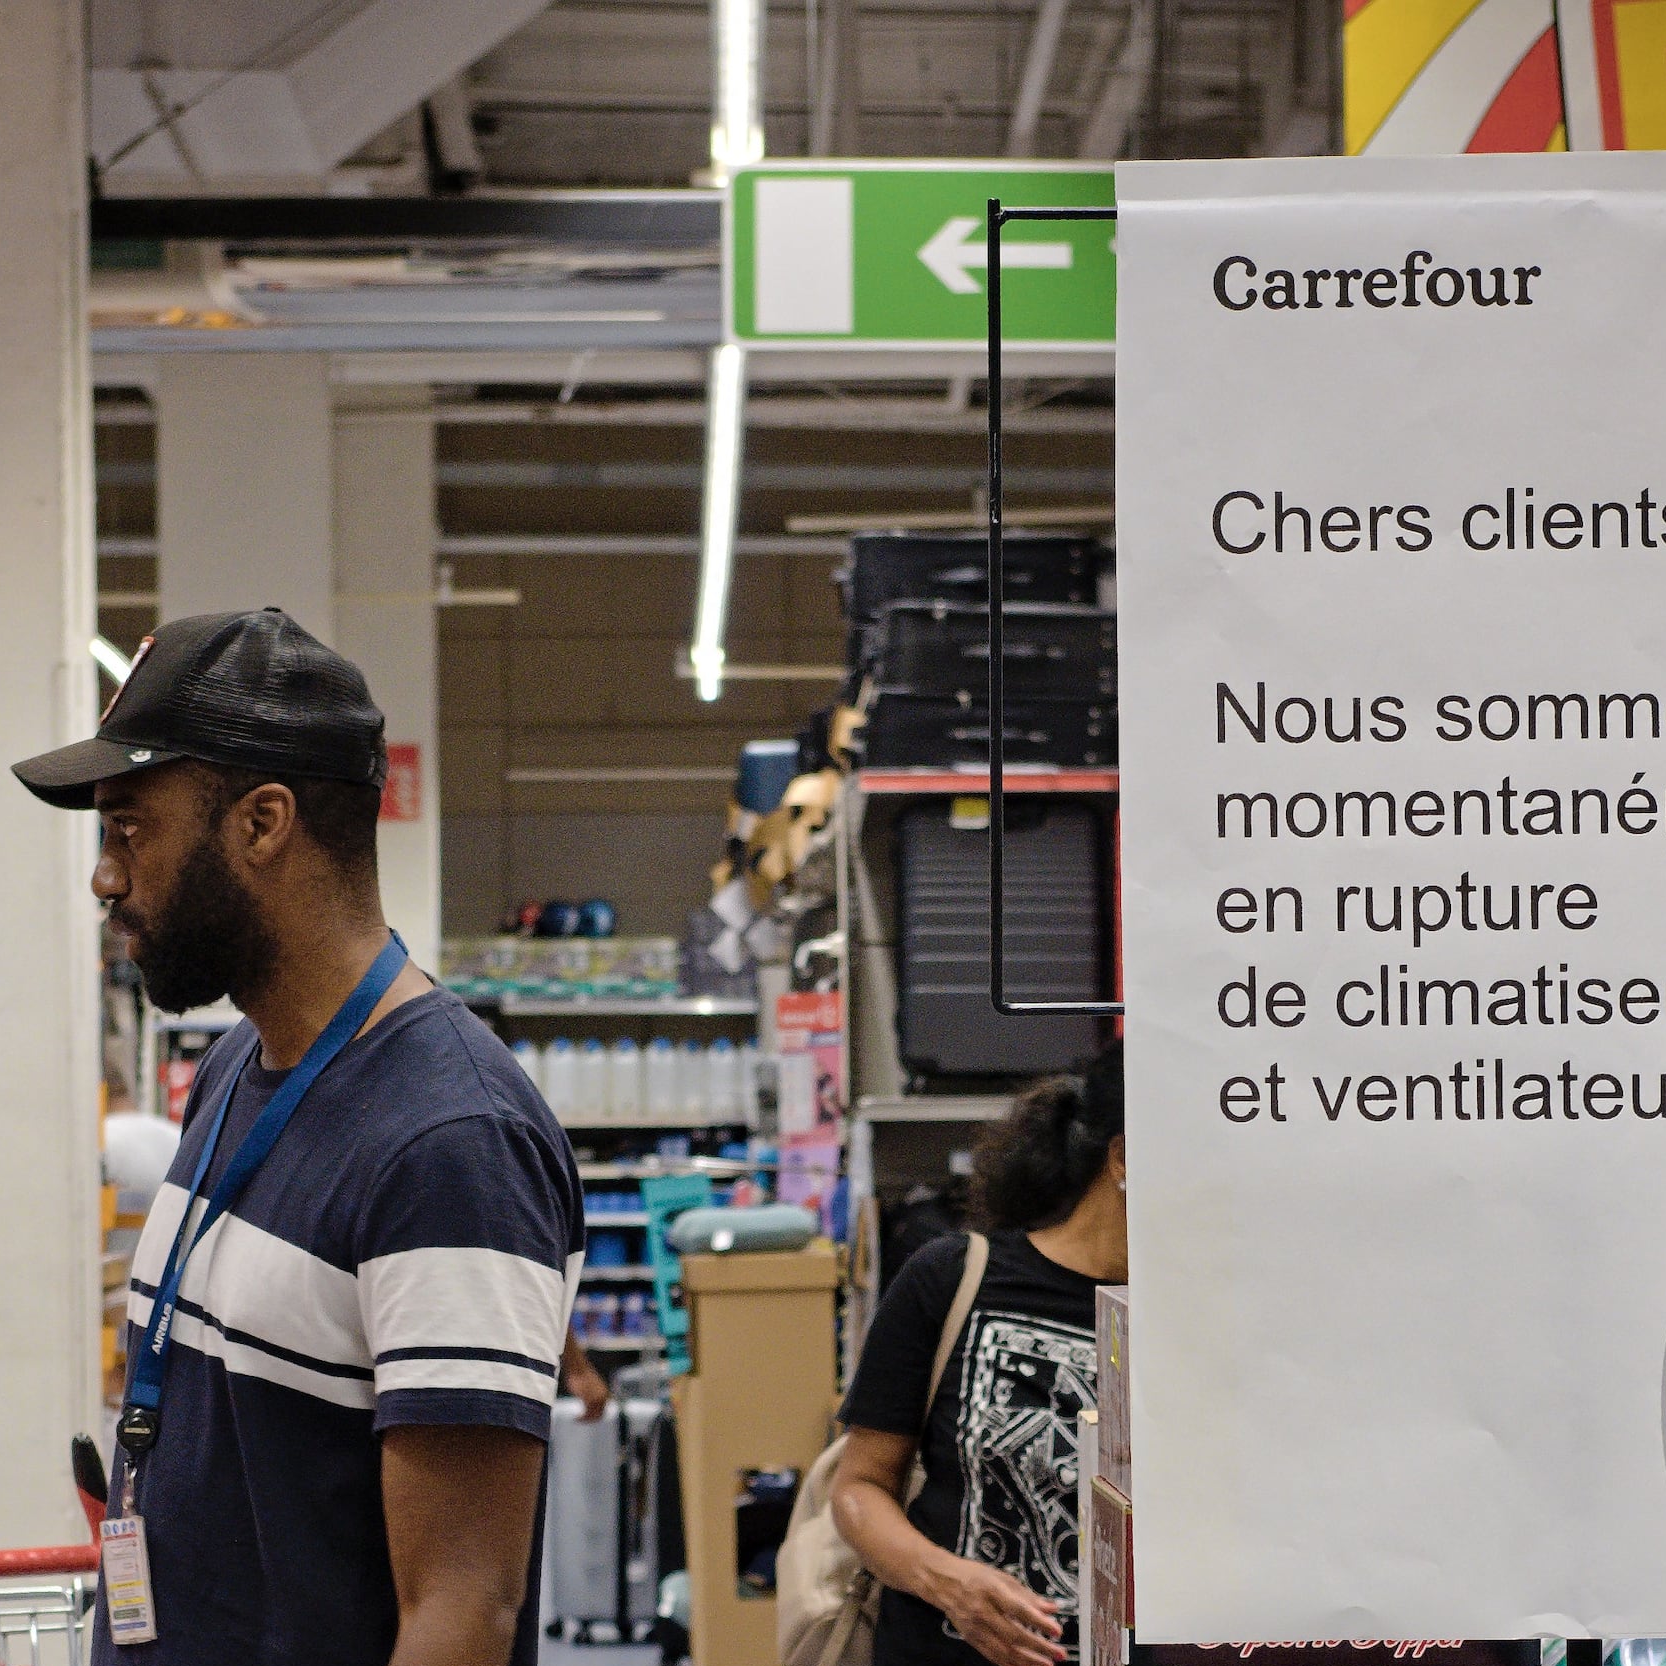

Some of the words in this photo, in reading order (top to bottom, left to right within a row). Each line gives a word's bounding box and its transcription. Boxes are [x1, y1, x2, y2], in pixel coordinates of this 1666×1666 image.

[1211, 251, 1542, 312] Carrefour
[1210, 488, 1433, 554] Chers
[1215, 681, 1407, 745] Nous
[1216, 882, 1305, 934] en
[1336, 871, 1599, 948] rupture
[1217, 968, 1307, 1029] de
[1219, 1063, 1287, 1124] et
[151, 1302, 173, 1356] AIRBUS
